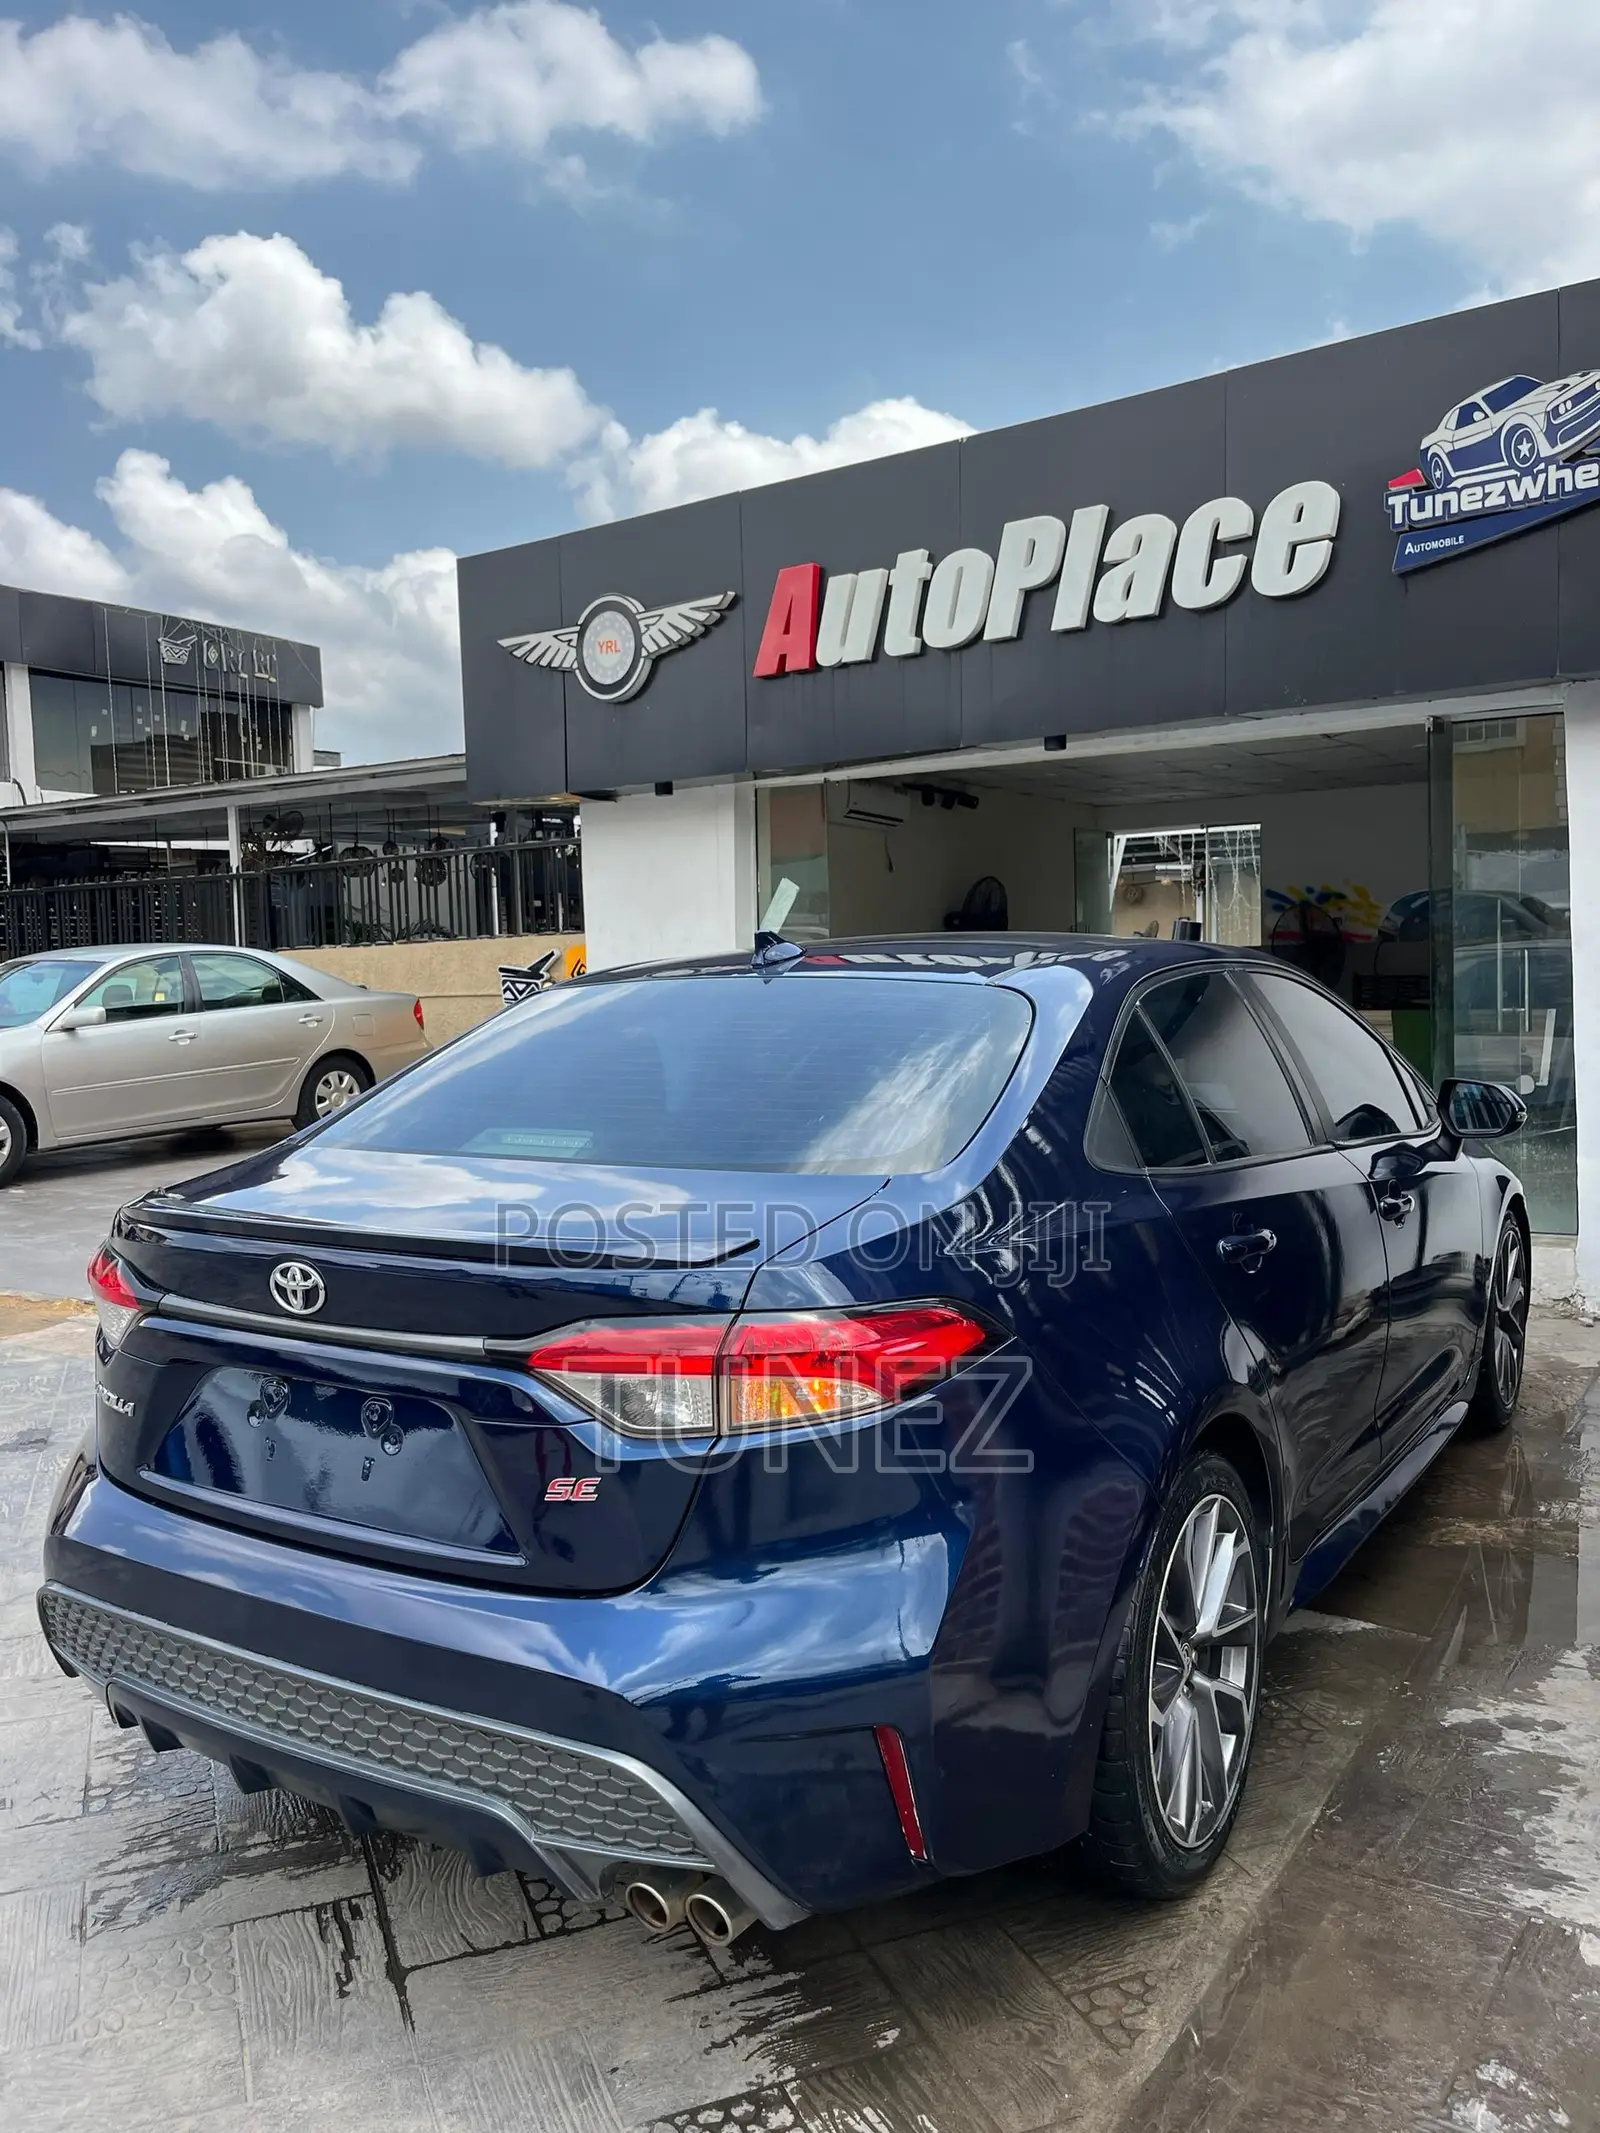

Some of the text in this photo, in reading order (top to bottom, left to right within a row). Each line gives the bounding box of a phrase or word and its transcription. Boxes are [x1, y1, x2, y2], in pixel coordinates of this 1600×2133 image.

[1388, 461, 1600, 524] Tunezwhe
[1404, 535, 1465, 555] AUTOMOBILE
[753, 480, 1341, 679] AutoPlace
[597, 639, 621, 655] YRL
[544, 1477, 602, 1501] SE
